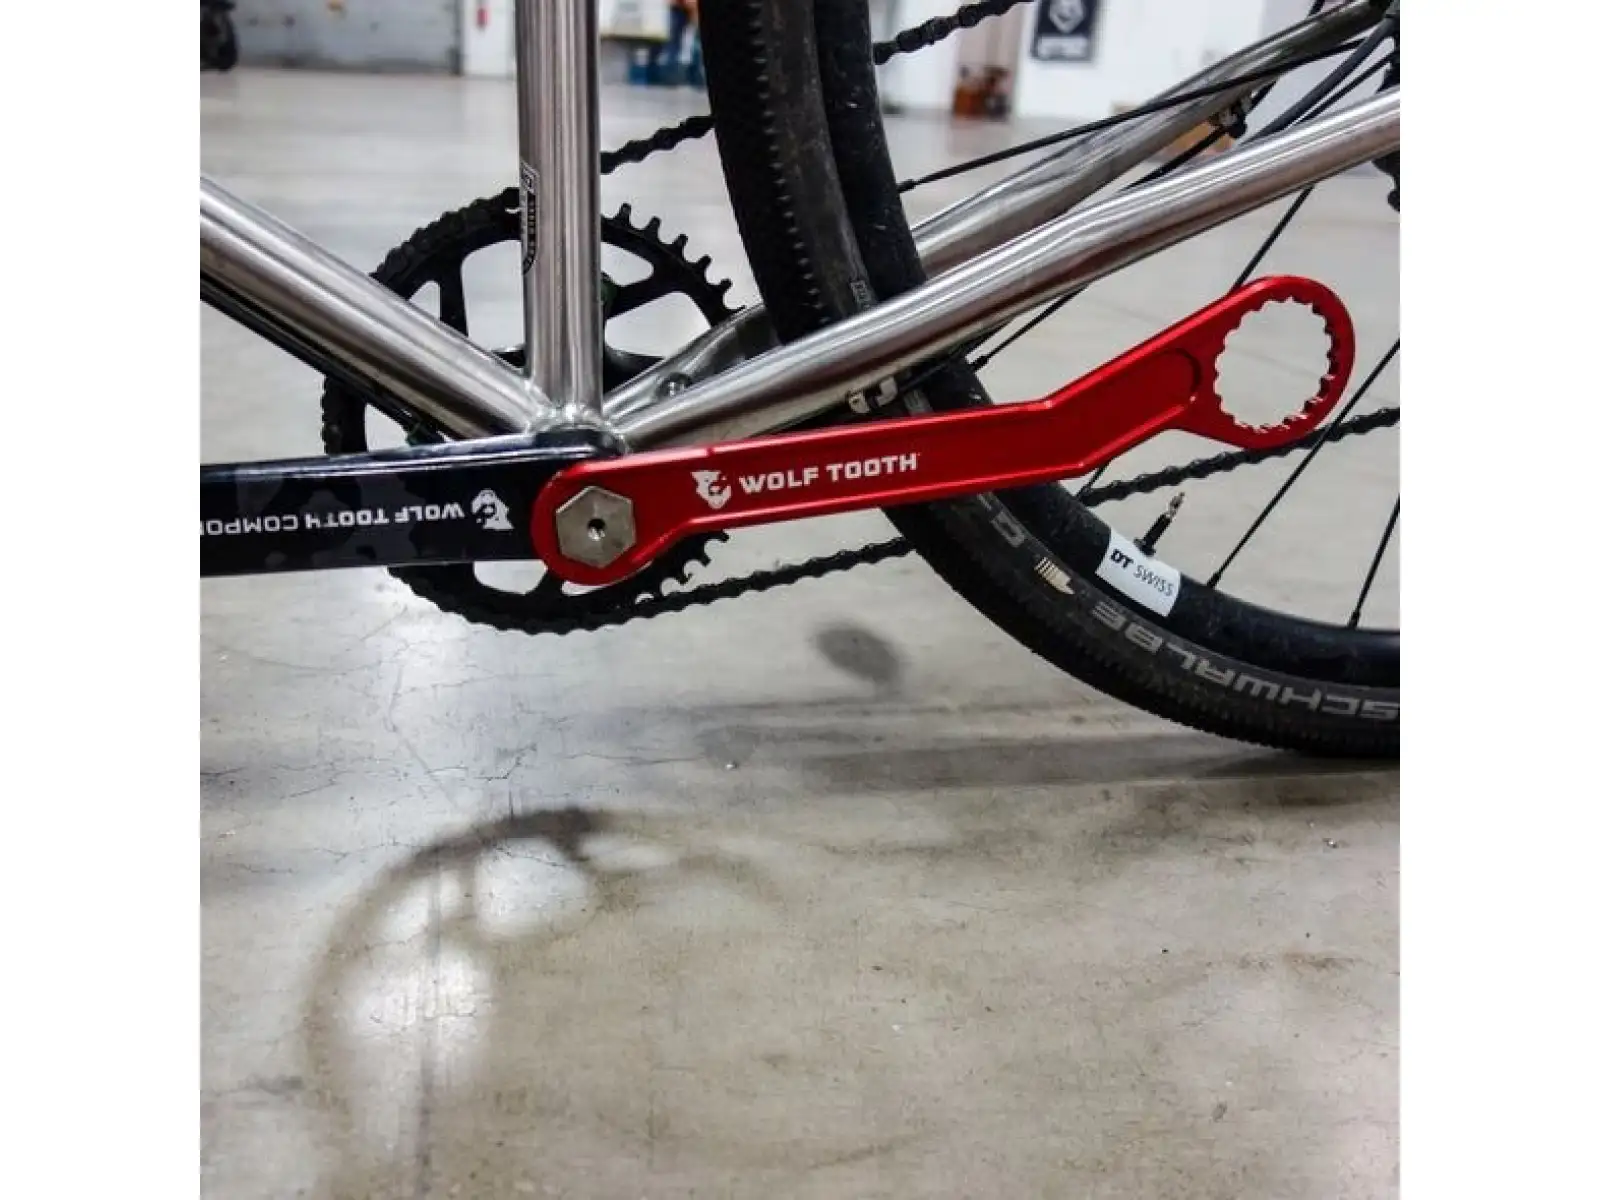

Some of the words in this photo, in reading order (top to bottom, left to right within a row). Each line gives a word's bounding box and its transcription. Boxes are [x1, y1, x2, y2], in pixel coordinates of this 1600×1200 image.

[738, 467, 819, 494] WOLF
[826, 452, 918, 482] TOOTH
[304, 507, 389, 530] TOOTH
[395, 502, 465, 524] WOLF
[1110, 548, 1134, 569] DT
[1133, 564, 1175, 597] SWISS
[1090, 600, 1400, 721] SCHWALBE
